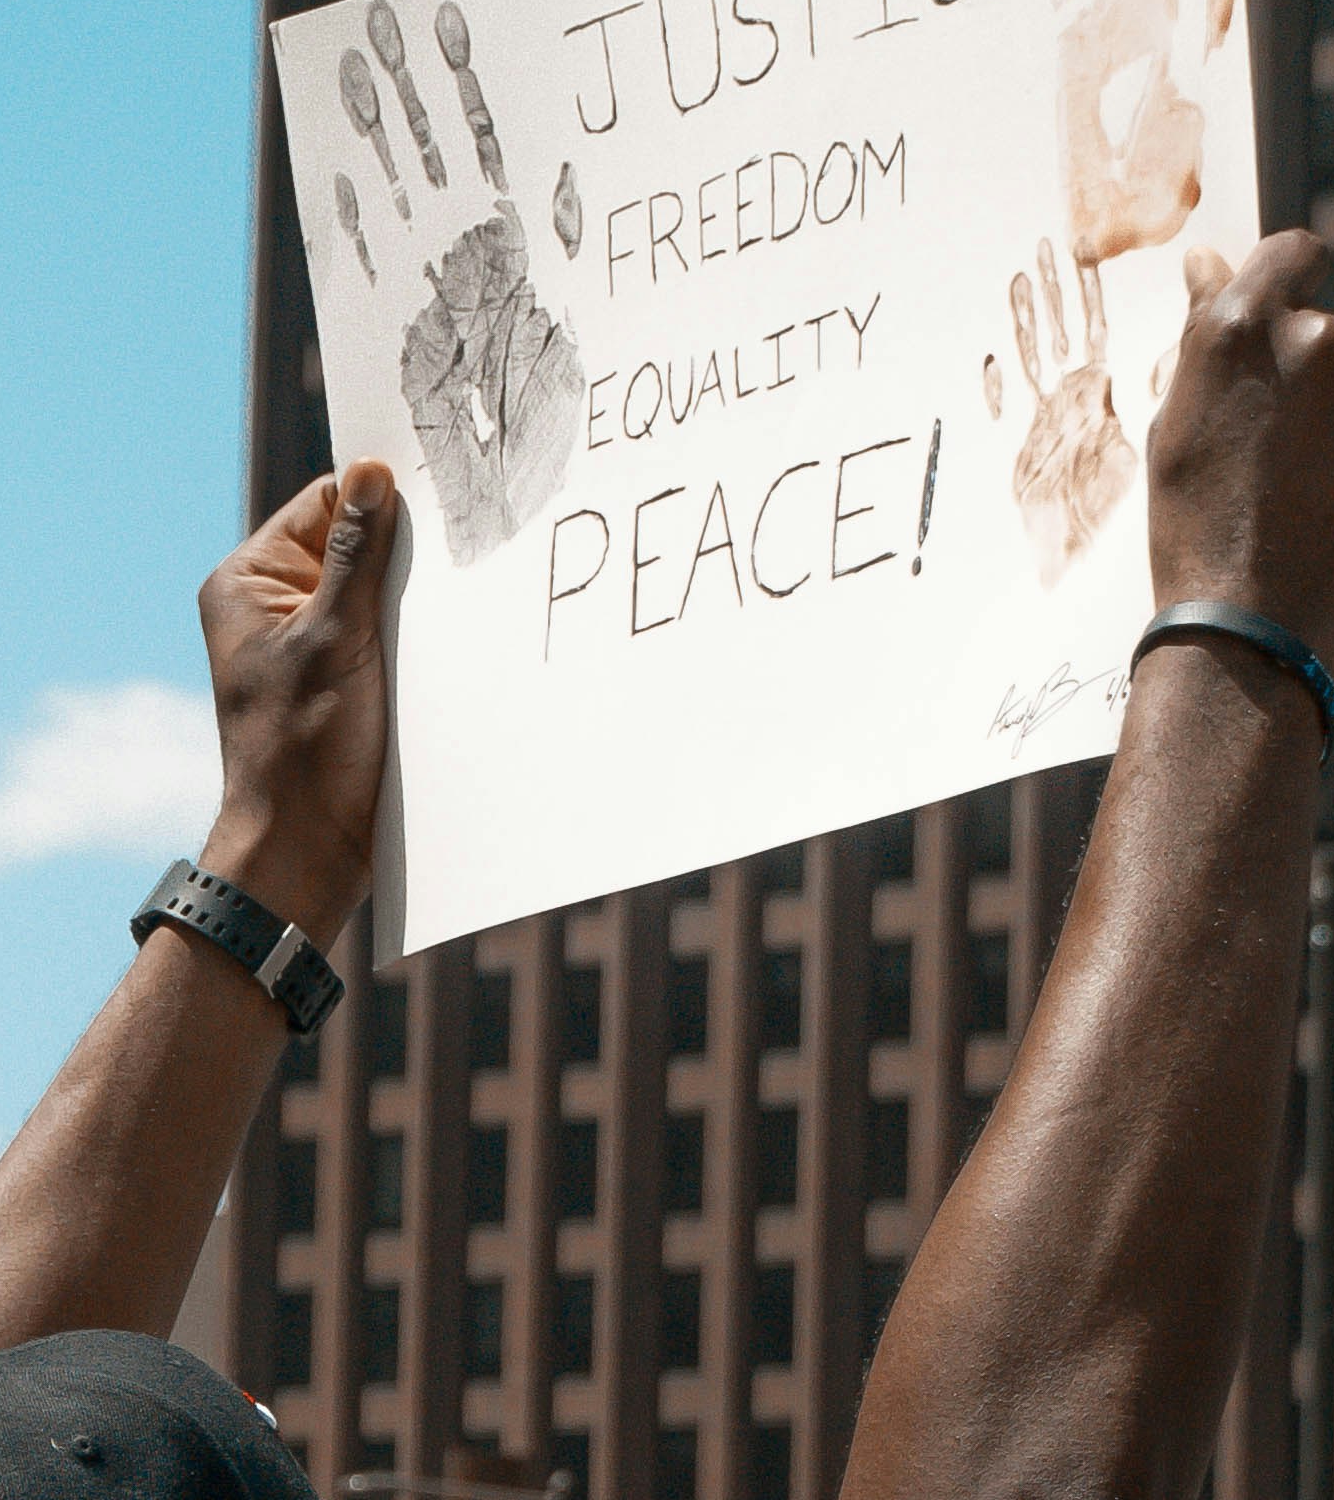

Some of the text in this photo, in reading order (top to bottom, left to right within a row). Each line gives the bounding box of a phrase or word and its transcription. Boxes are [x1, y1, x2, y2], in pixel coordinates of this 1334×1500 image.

[607, 131, 906, 298] FREEDOM
[588, 293, 881, 450] EQUALITY
[544, 418, 943, 662] PEACE!
